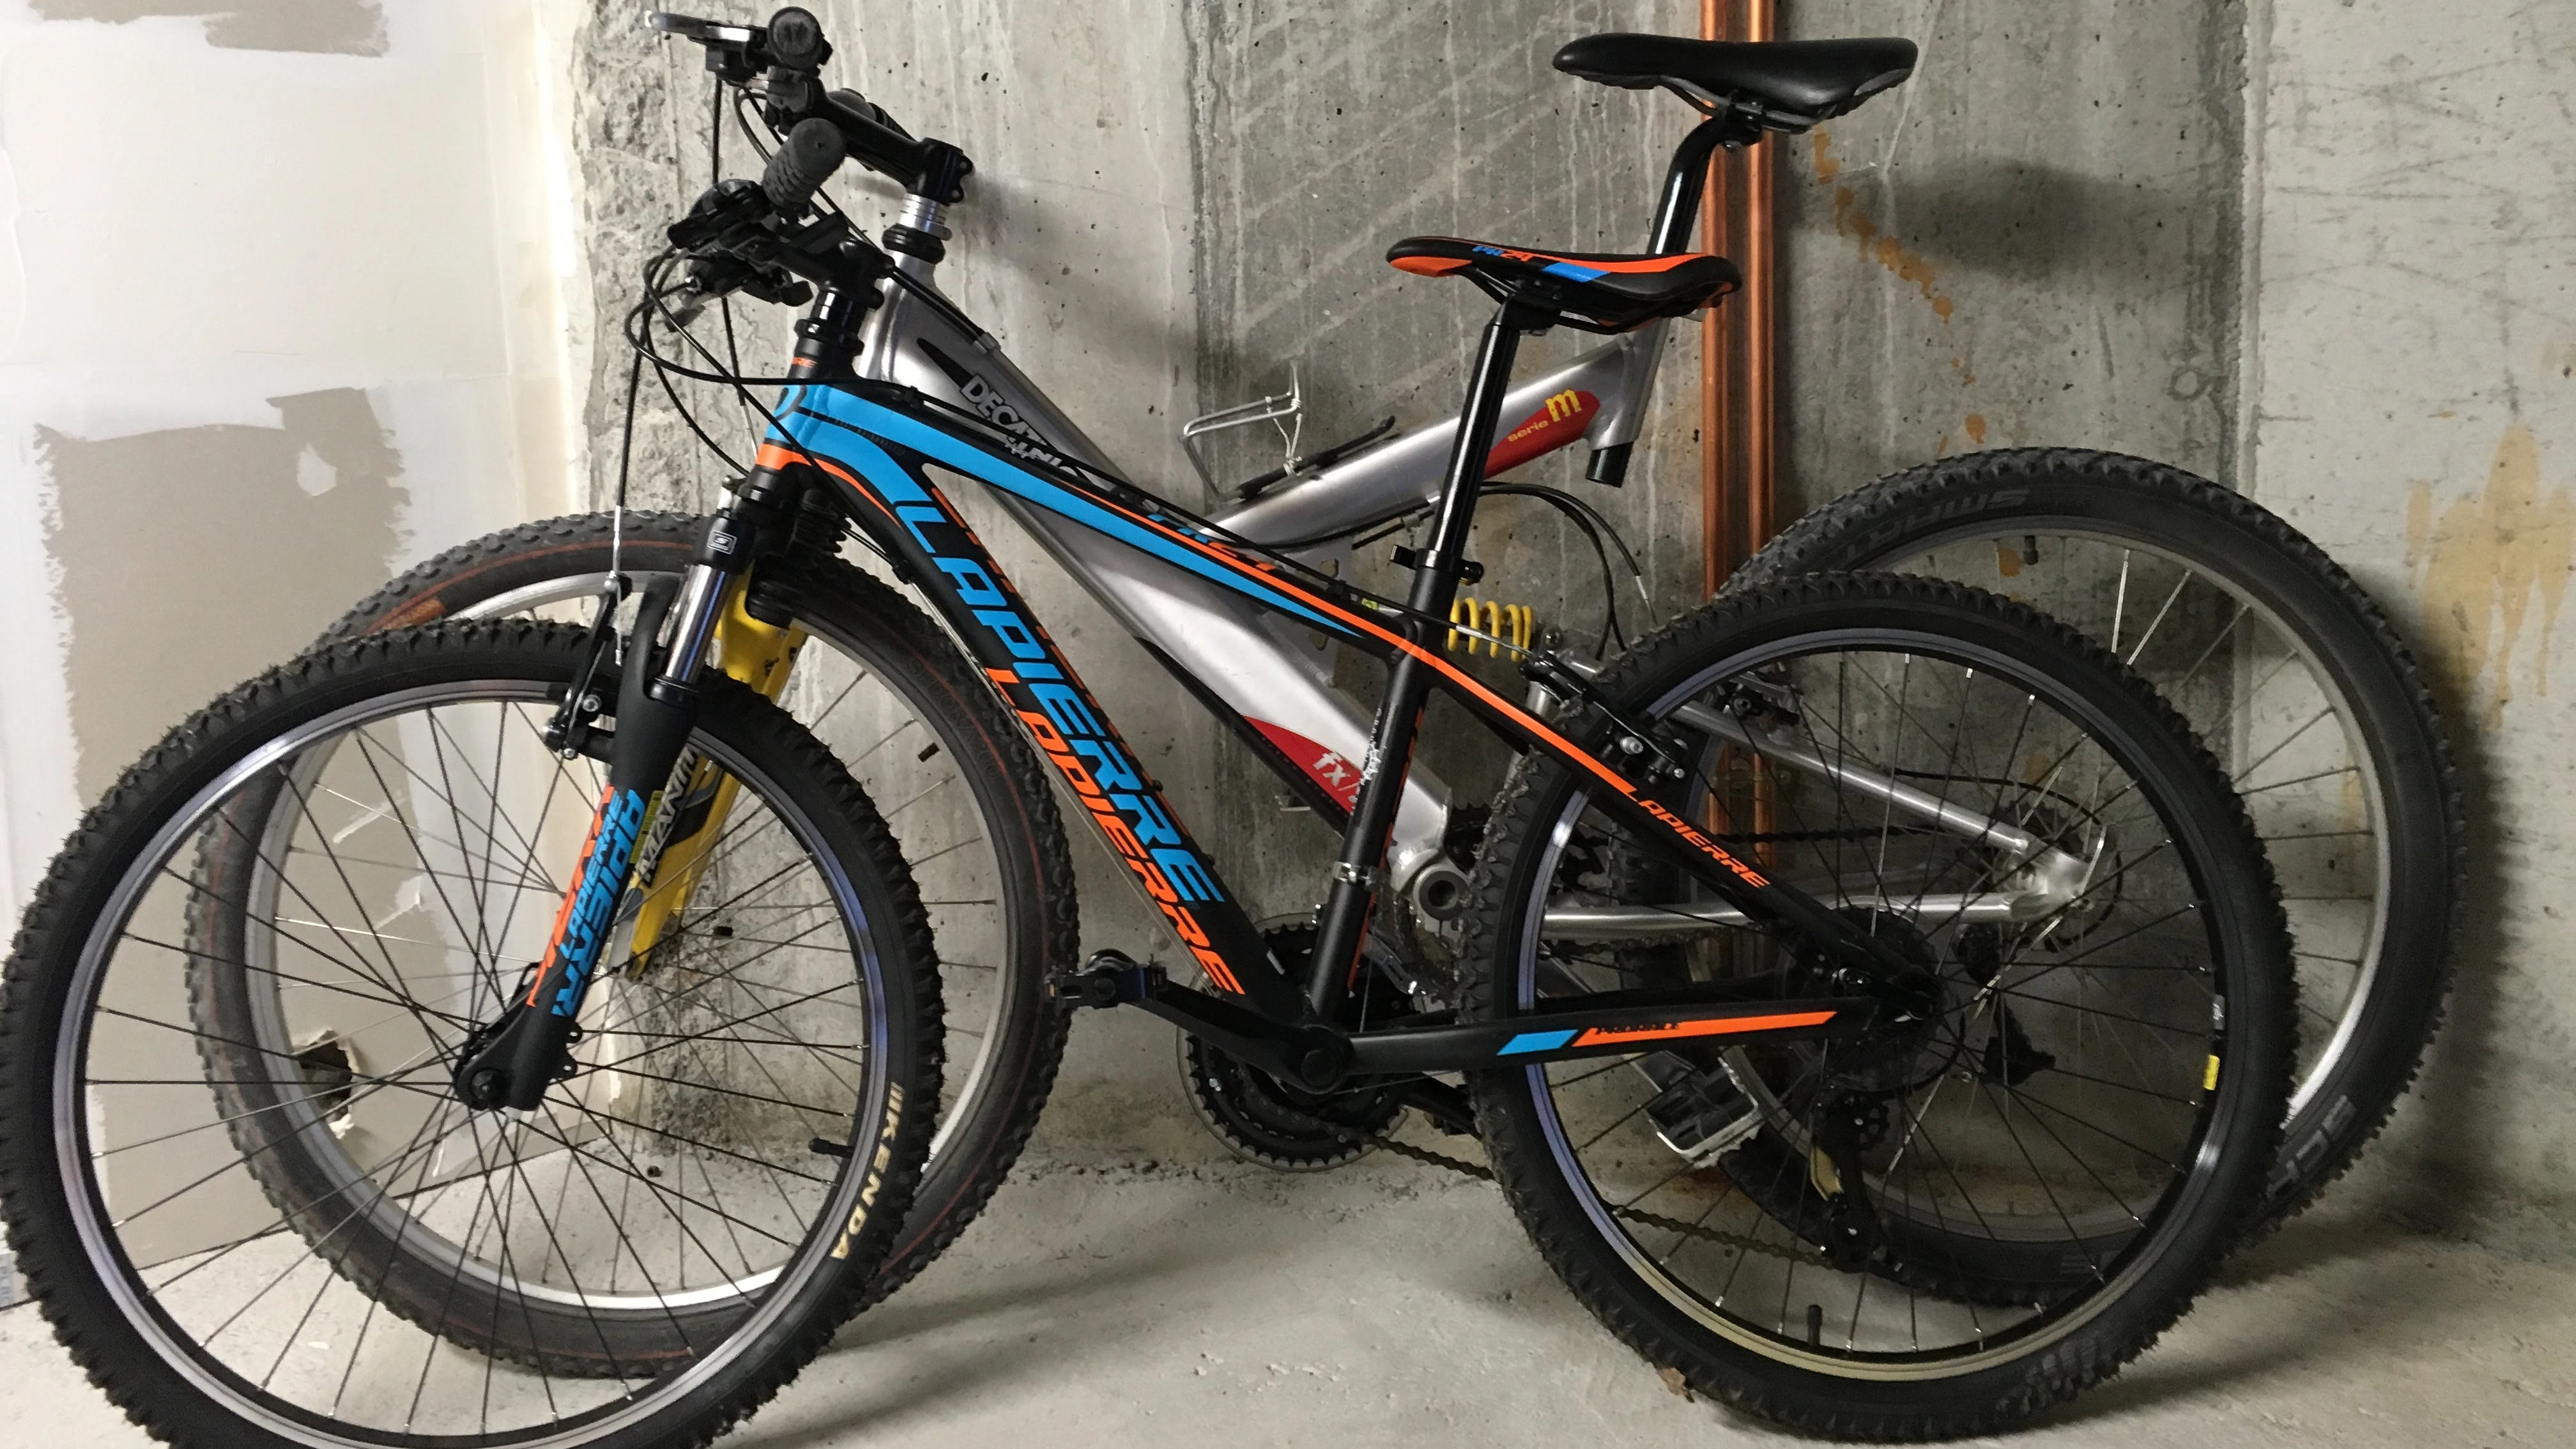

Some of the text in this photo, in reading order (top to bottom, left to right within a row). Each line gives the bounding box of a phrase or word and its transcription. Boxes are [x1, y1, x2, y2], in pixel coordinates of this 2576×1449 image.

[895, 504, 1225, 903] LAPIERRE
[985, 667, 1245, 995] LAPIERRE
[559, 790, 624, 959] LAPIERRE
